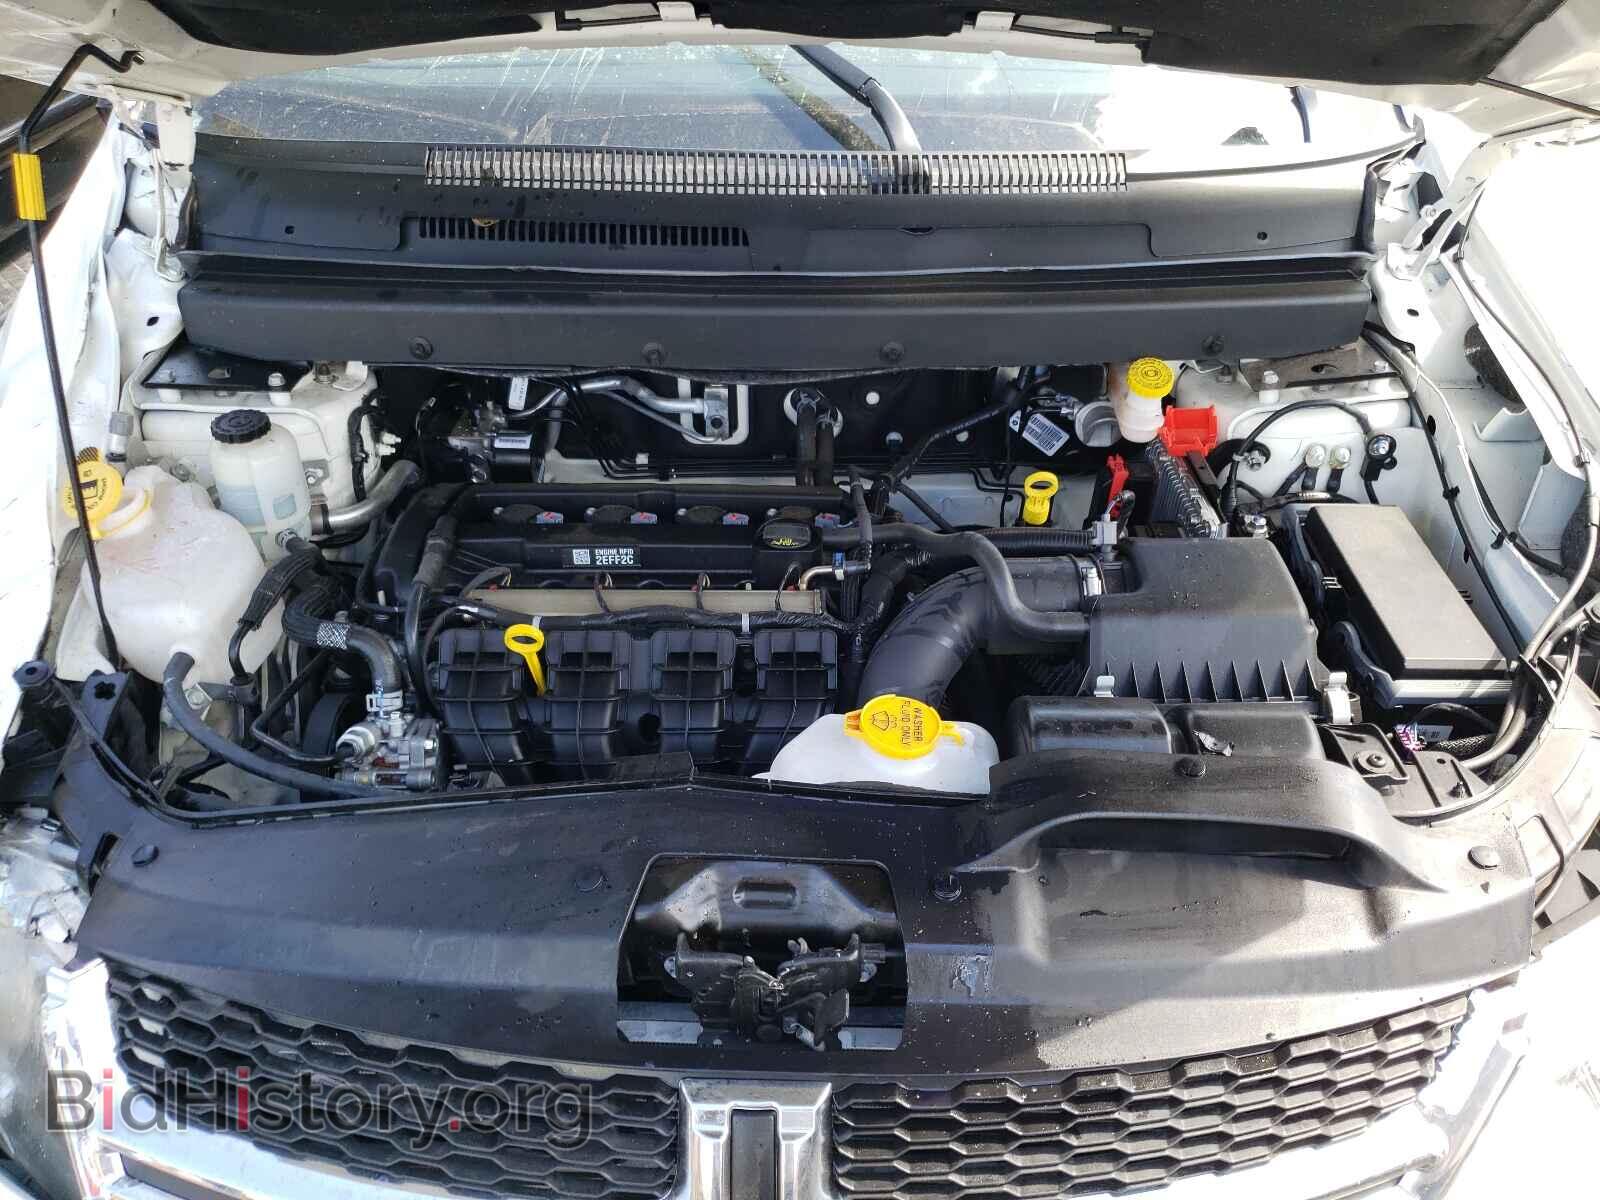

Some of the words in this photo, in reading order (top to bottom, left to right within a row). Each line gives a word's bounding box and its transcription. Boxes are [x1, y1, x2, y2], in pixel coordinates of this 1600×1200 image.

[596, 556, 634, 565] 2EFF2C
[900, 700, 911, 722] FLUID
[900, 724, 911, 746] ONLY
[912, 707, 924, 742] WASHER
